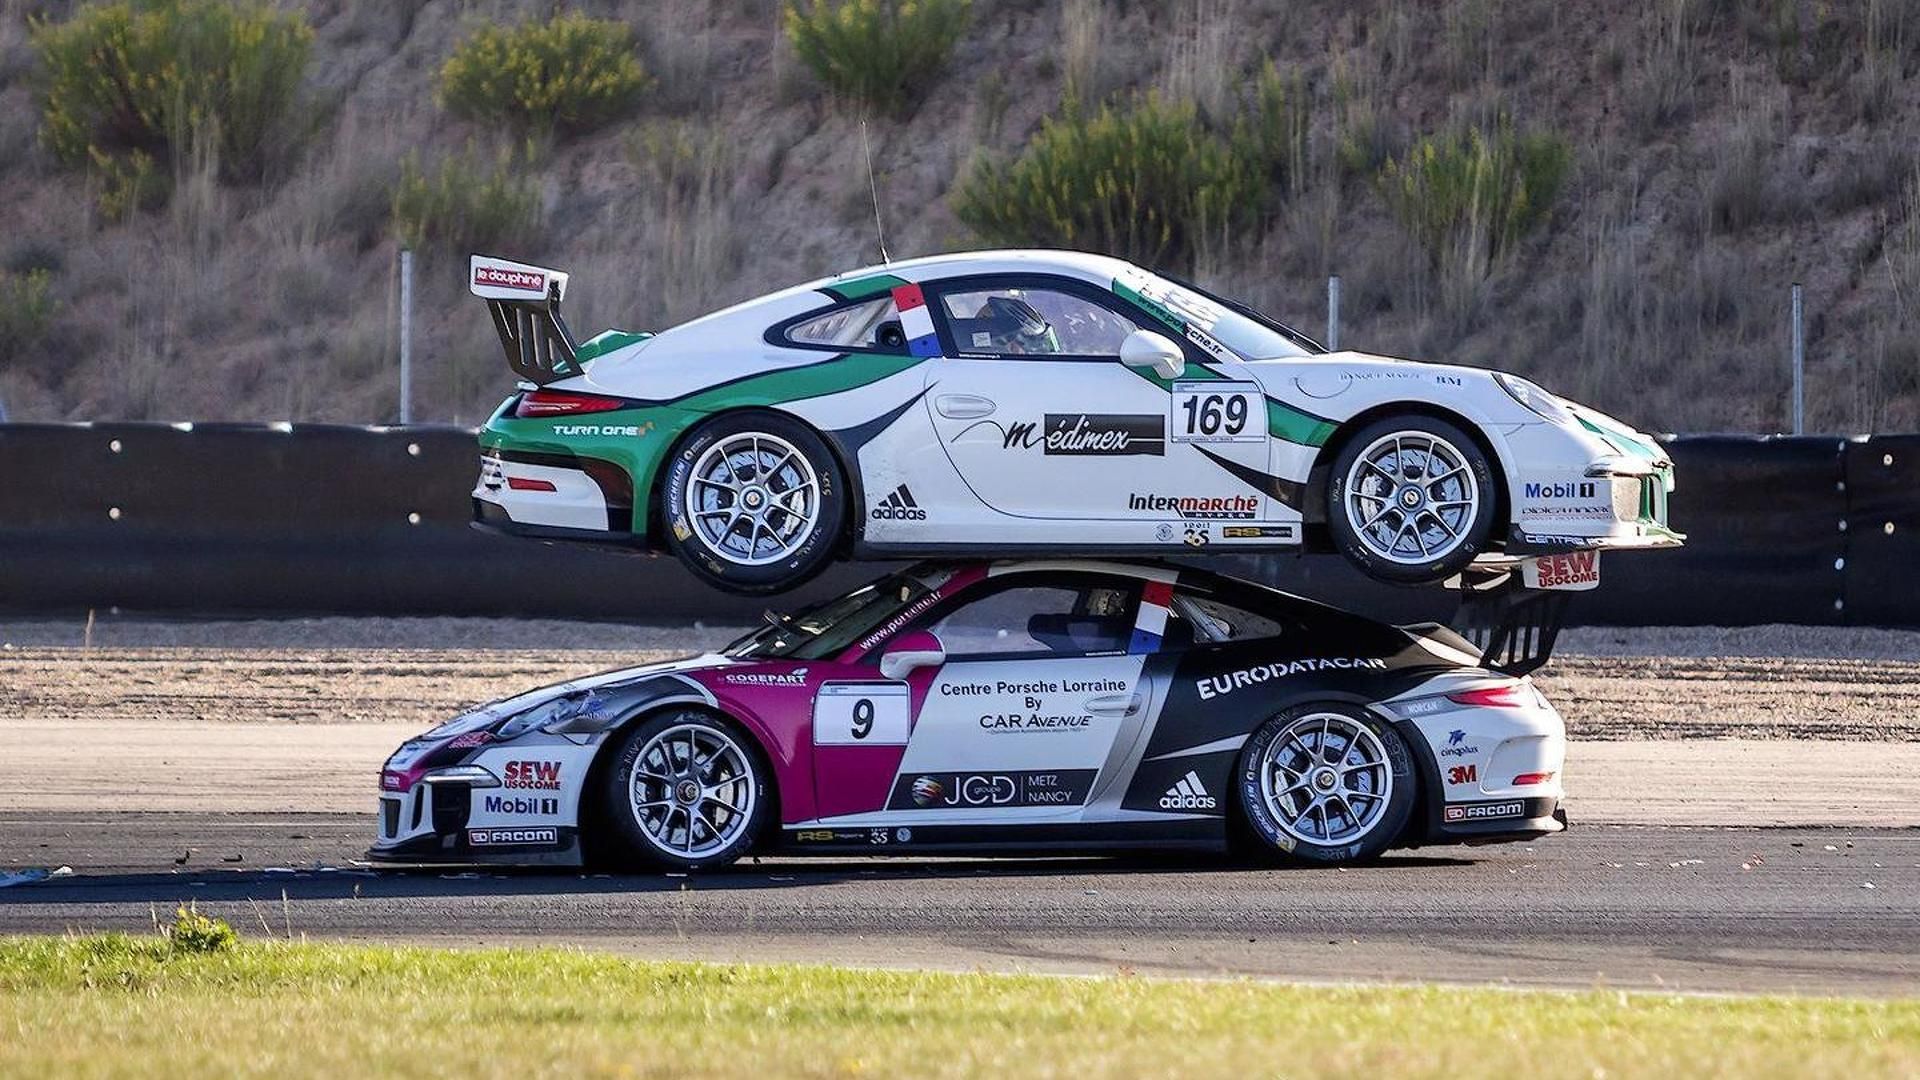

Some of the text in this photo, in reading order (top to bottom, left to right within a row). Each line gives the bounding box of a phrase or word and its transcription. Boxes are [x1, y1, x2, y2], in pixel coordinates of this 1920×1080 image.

[1183, 394, 1247, 435] 169
[553, 426, 600, 436] TURN
[1525, 483, 1575, 498] Mobil
[871, 507, 927, 520] adidas
[1128, 494, 1258, 518] Intermarché
[1536, 551, 1595, 577] SEW
[1538, 571, 1599, 588] USOCOME
[1196, 658, 1388, 700] EURODATACAR
[941, 679, 1127, 696] Centre Porsche Lorraine
[1025, 697, 1043, 710] By
[851, 698, 875, 739] 9
[979, 713, 1094, 729] CAR AVENUE
[504, 761, 562, 781] SEW
[1448, 764, 1477, 785] 3M
[504, 779, 562, 790] USOCOME
[1029, 775, 1057, 787] METZ
[485, 797, 538, 814] Mobil
[1029, 792, 1072, 803] NANCY
[1159, 795, 1216, 809] adidas
[1467, 804, 1521, 816] FACOM
[492, 832, 554, 842] FACOM
